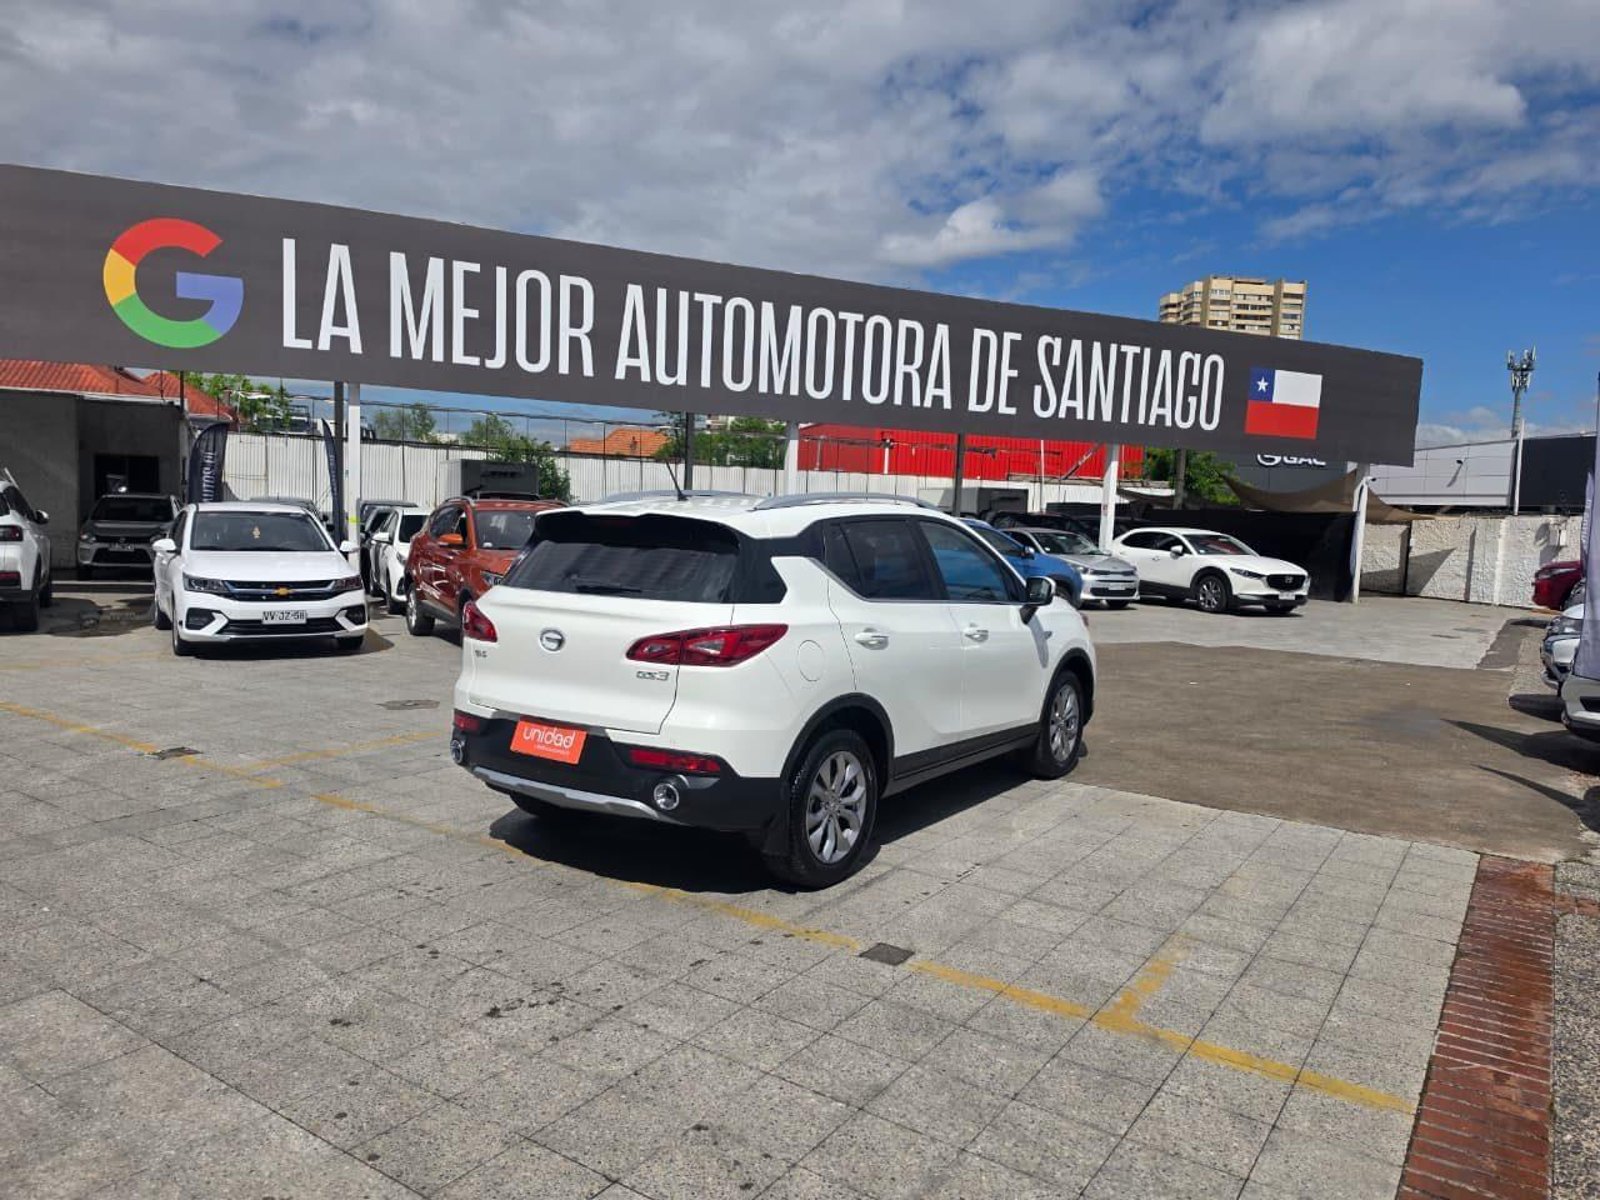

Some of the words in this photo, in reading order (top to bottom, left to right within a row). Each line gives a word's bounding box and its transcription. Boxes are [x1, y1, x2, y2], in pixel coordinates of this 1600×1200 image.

[283, 238, 362, 354] LA
[390, 252, 594, 376] MEJOR
[615, 284, 951, 409] AUTOMOTORA
[968, 328, 1021, 414] DE
[1034, 335, 1224, 430] SANTIAGO
[523, 725, 576, 749] unidad
